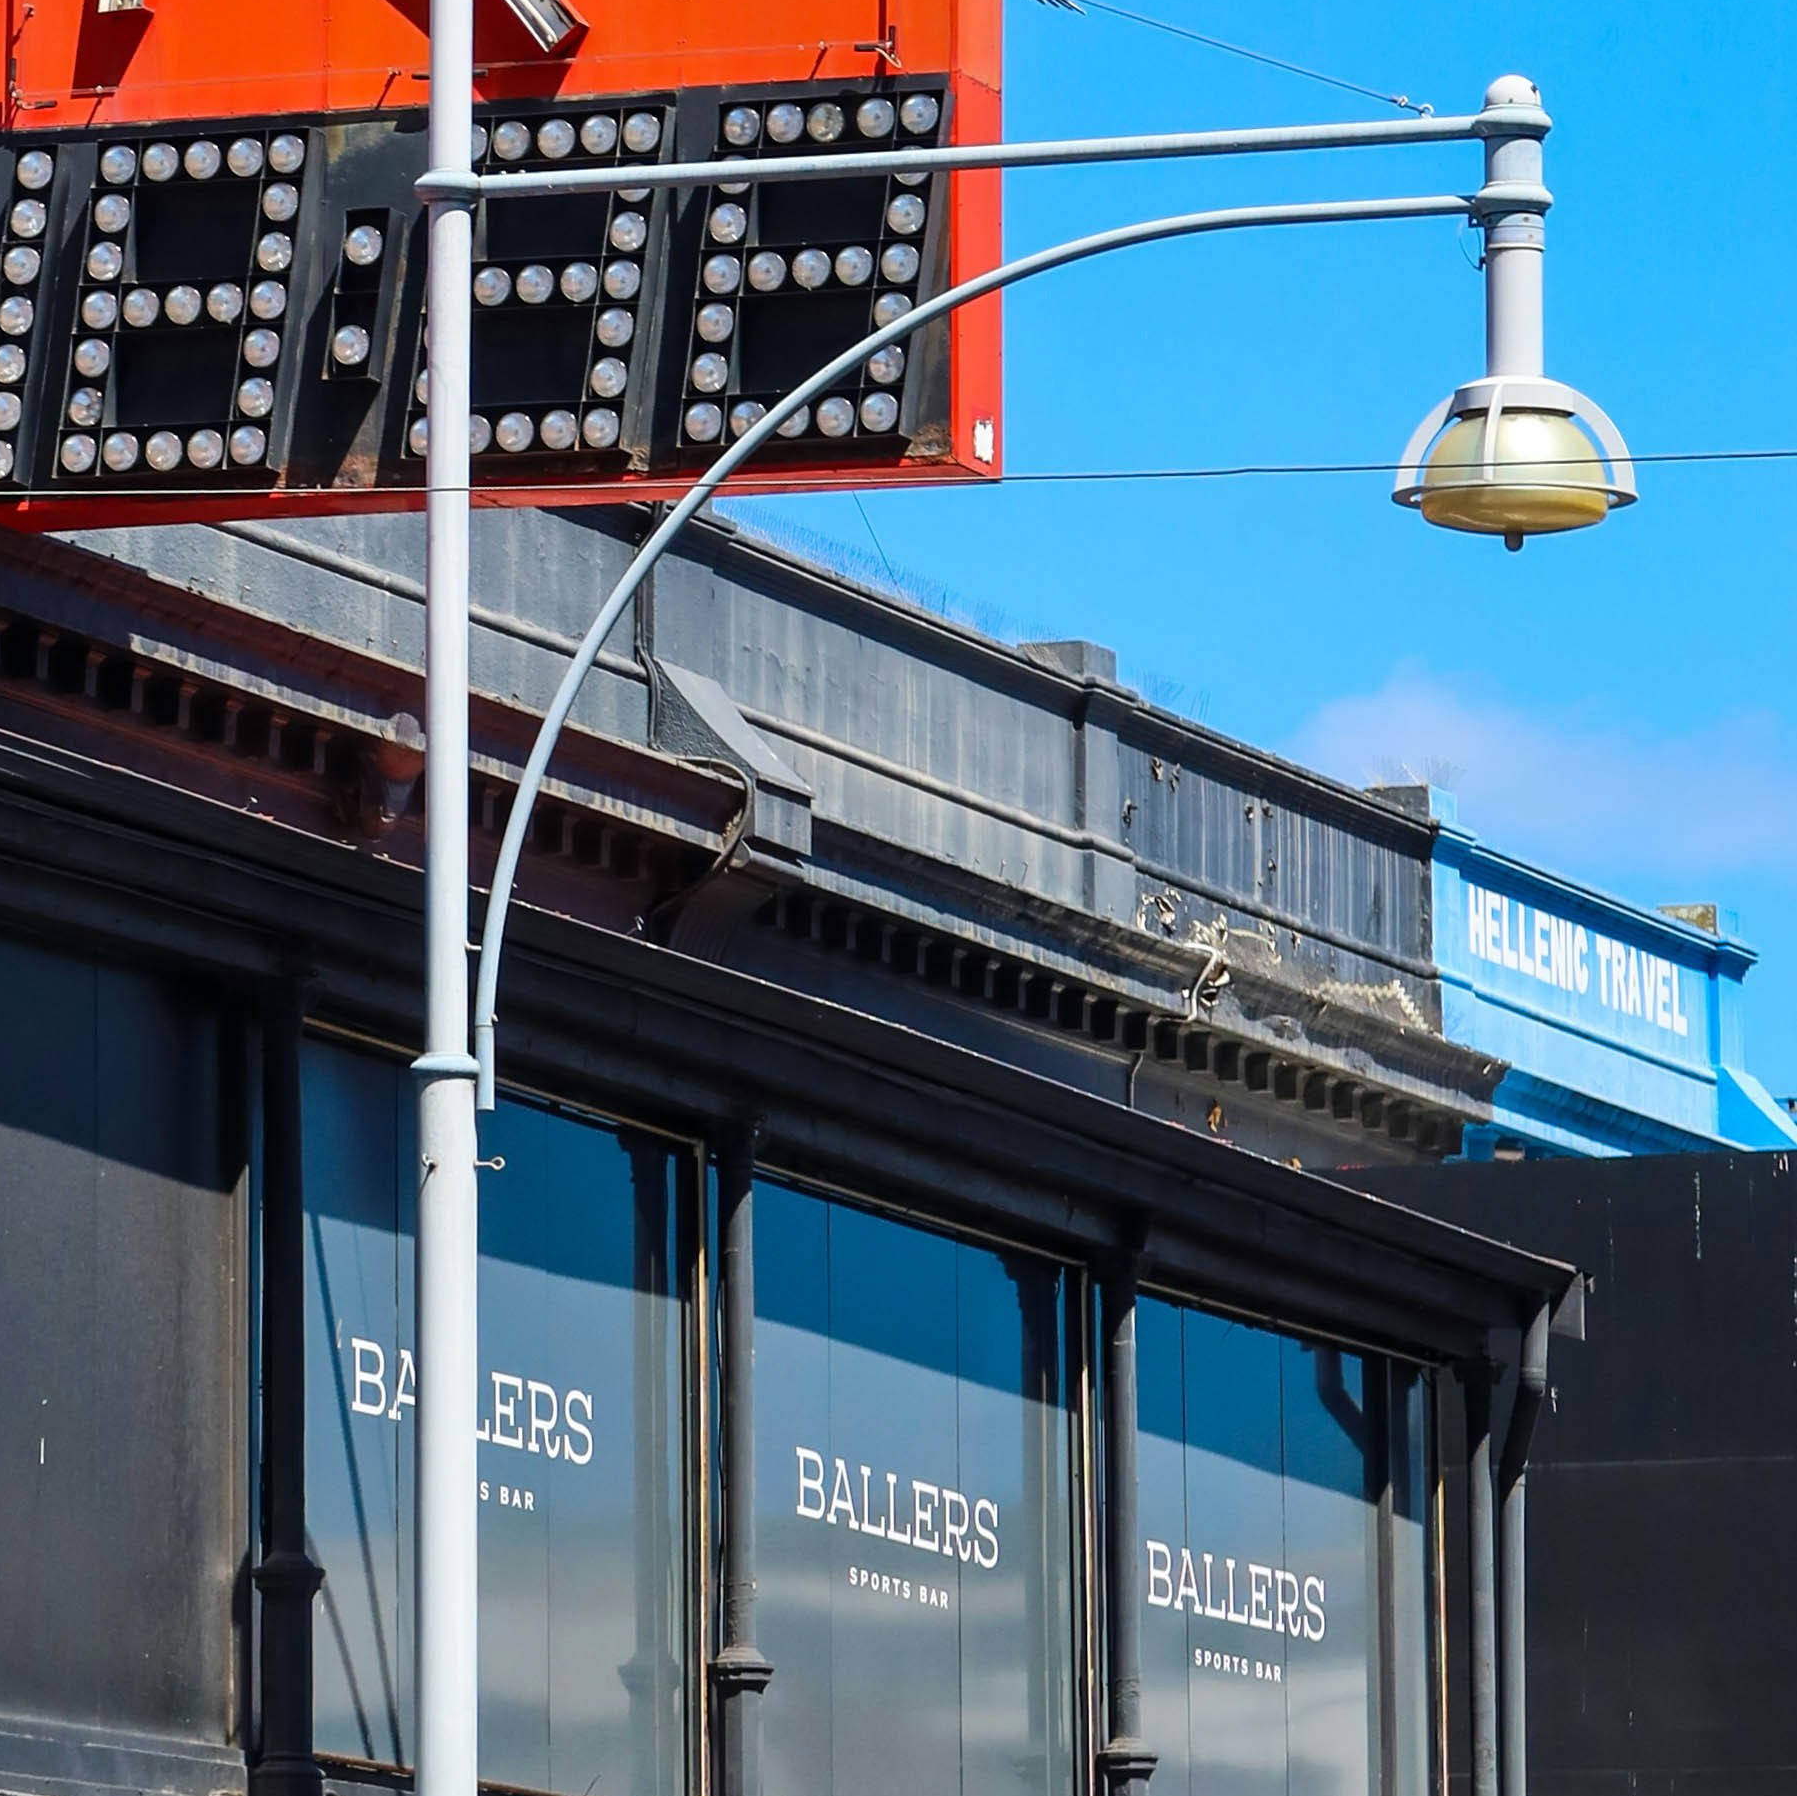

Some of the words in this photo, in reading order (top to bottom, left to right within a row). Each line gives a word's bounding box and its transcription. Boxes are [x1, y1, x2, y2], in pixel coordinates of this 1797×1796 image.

[1468, 881, 1589, 995] HELLENIC
[1595, 933, 1688, 1036] TRAVEL
[351, 1337, 594, 1465] BAERS
[500, 1485, 535, 1511] BAR
[796, 1446, 999, 1569] BALLERS
[849, 1566, 911, 1599] SPORTS
[920, 1585, 949, 1610] BAR
[1146, 1540, 1326, 1642] BALLERS
[1194, 1648, 1248, 1676] SPORTS
[1256, 1662, 1282, 1683] BAR
